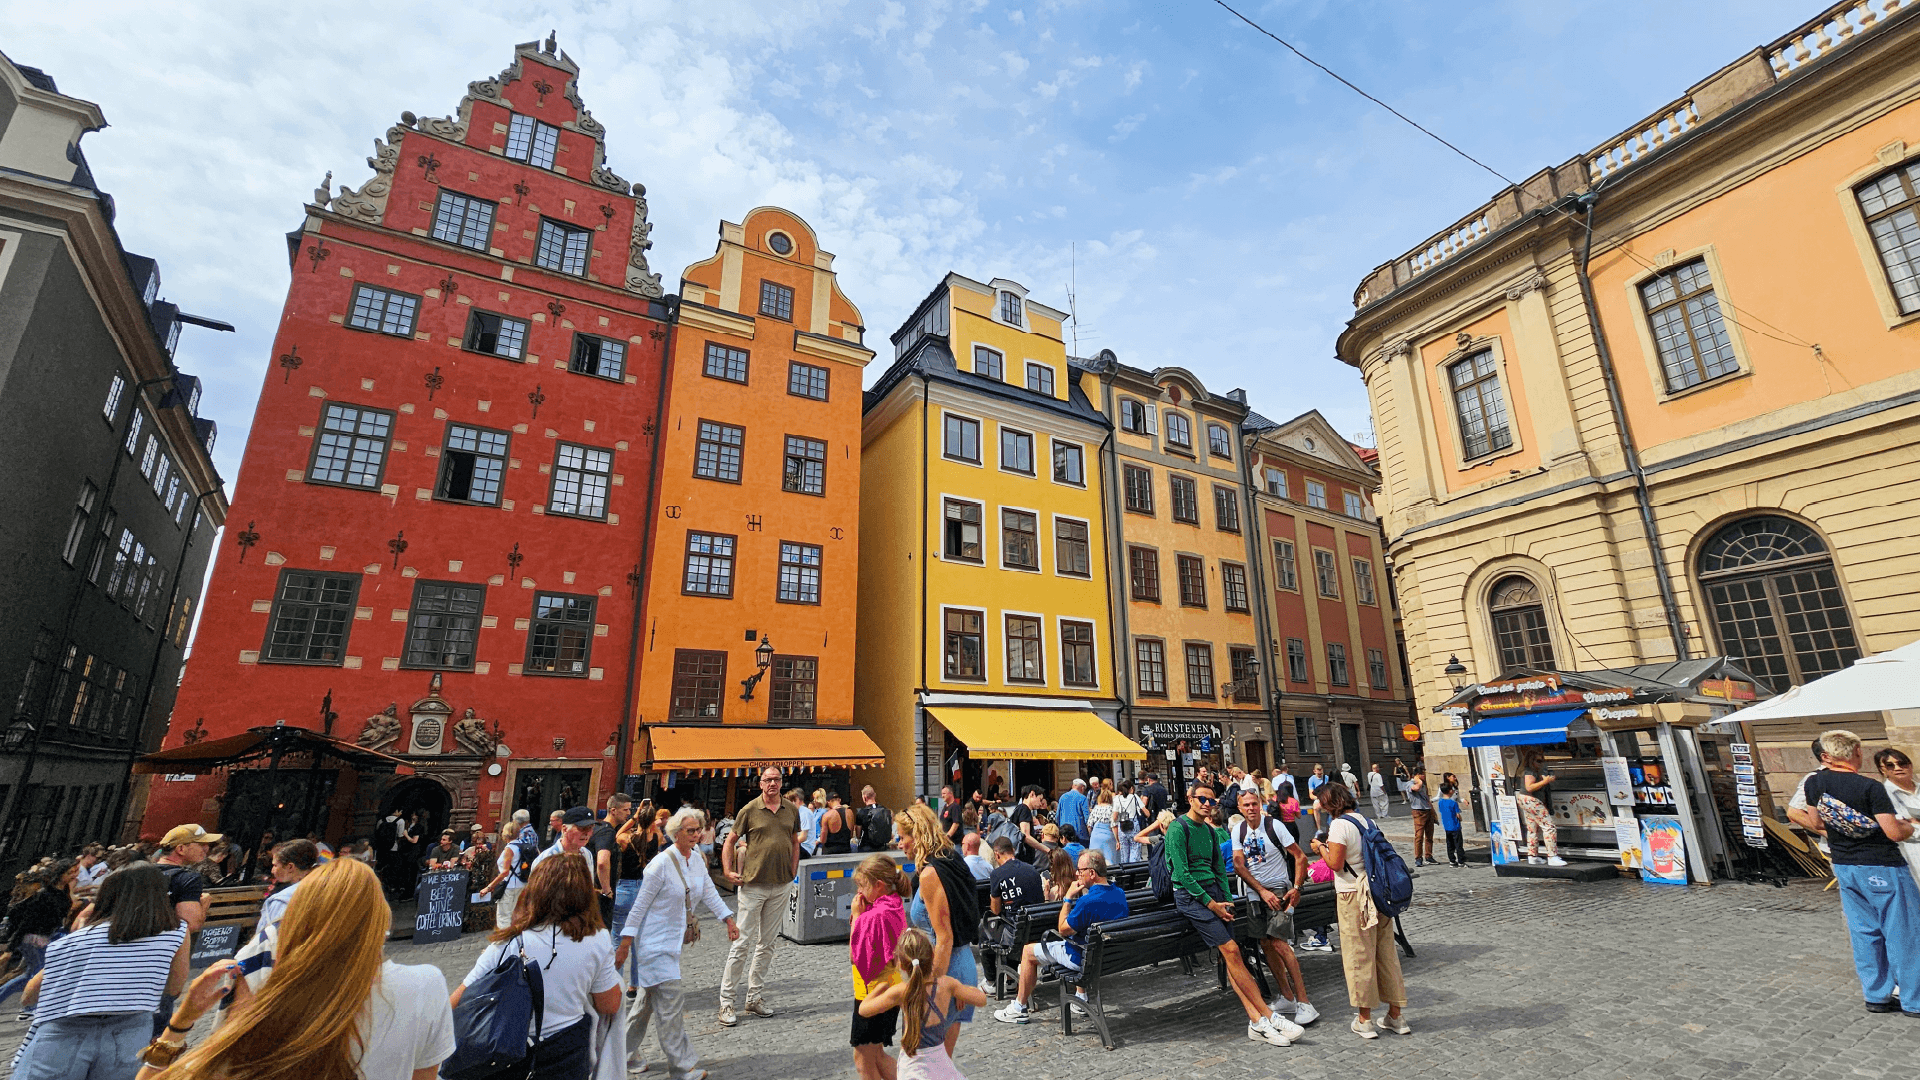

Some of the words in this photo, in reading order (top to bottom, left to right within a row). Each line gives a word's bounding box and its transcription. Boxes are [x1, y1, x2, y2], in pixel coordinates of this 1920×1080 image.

[1583, 691, 1629, 703] Churros
[1597, 708, 1638, 720] Crepes
[1155, 723, 1209, 733] RUNSTENEN
[427, 875, 439, 885] WE
[440, 873, 461, 883] SERVE
[1000, 877, 1016, 889] MY
[430, 886, 453, 900] BEER
[1001, 887, 1022, 900] GER
[429, 899, 452, 913] WINE
[416, 913, 437, 930] COFFEE
[438, 911, 462, 928] DRINKS
[202, 927, 233, 938] DAGENS
[202, 936, 228, 945] SOPPA
